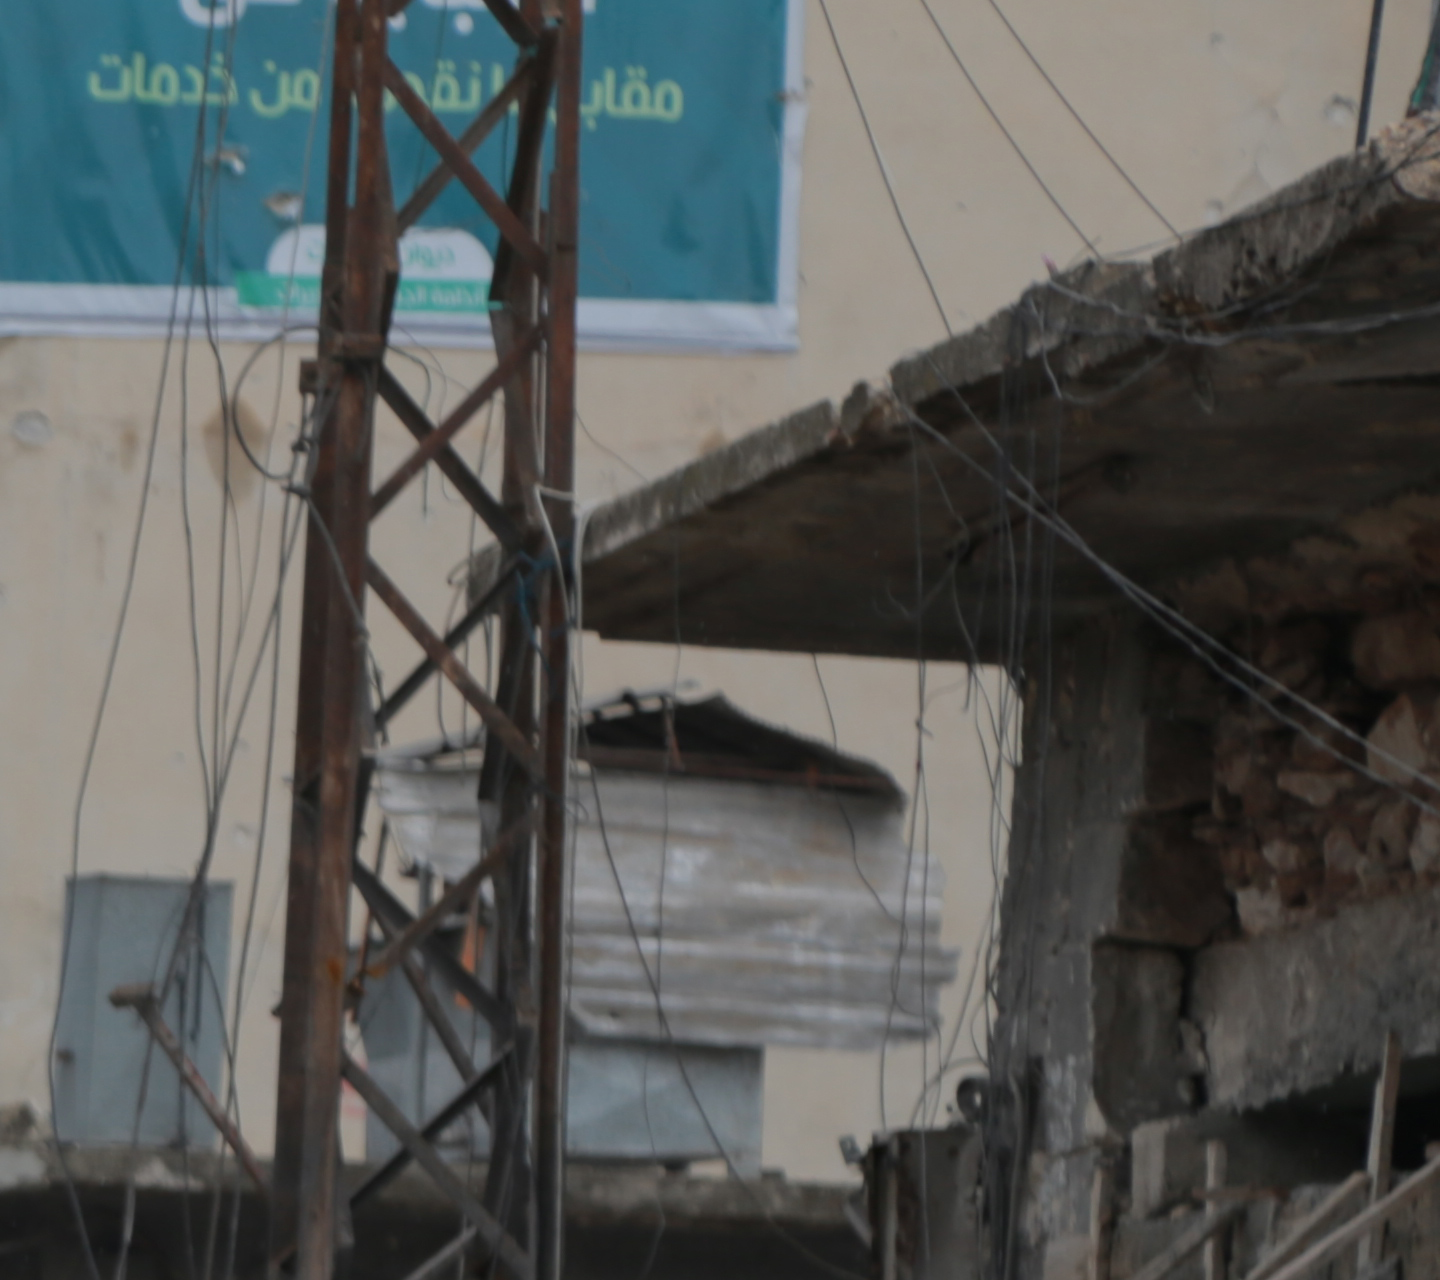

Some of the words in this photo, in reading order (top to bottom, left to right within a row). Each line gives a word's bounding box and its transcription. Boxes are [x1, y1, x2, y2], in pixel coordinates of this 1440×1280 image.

[86, 51, 240, 107] خدمات
[248, 59, 321, 120] من
[548, 65, 684, 129] مقاب
